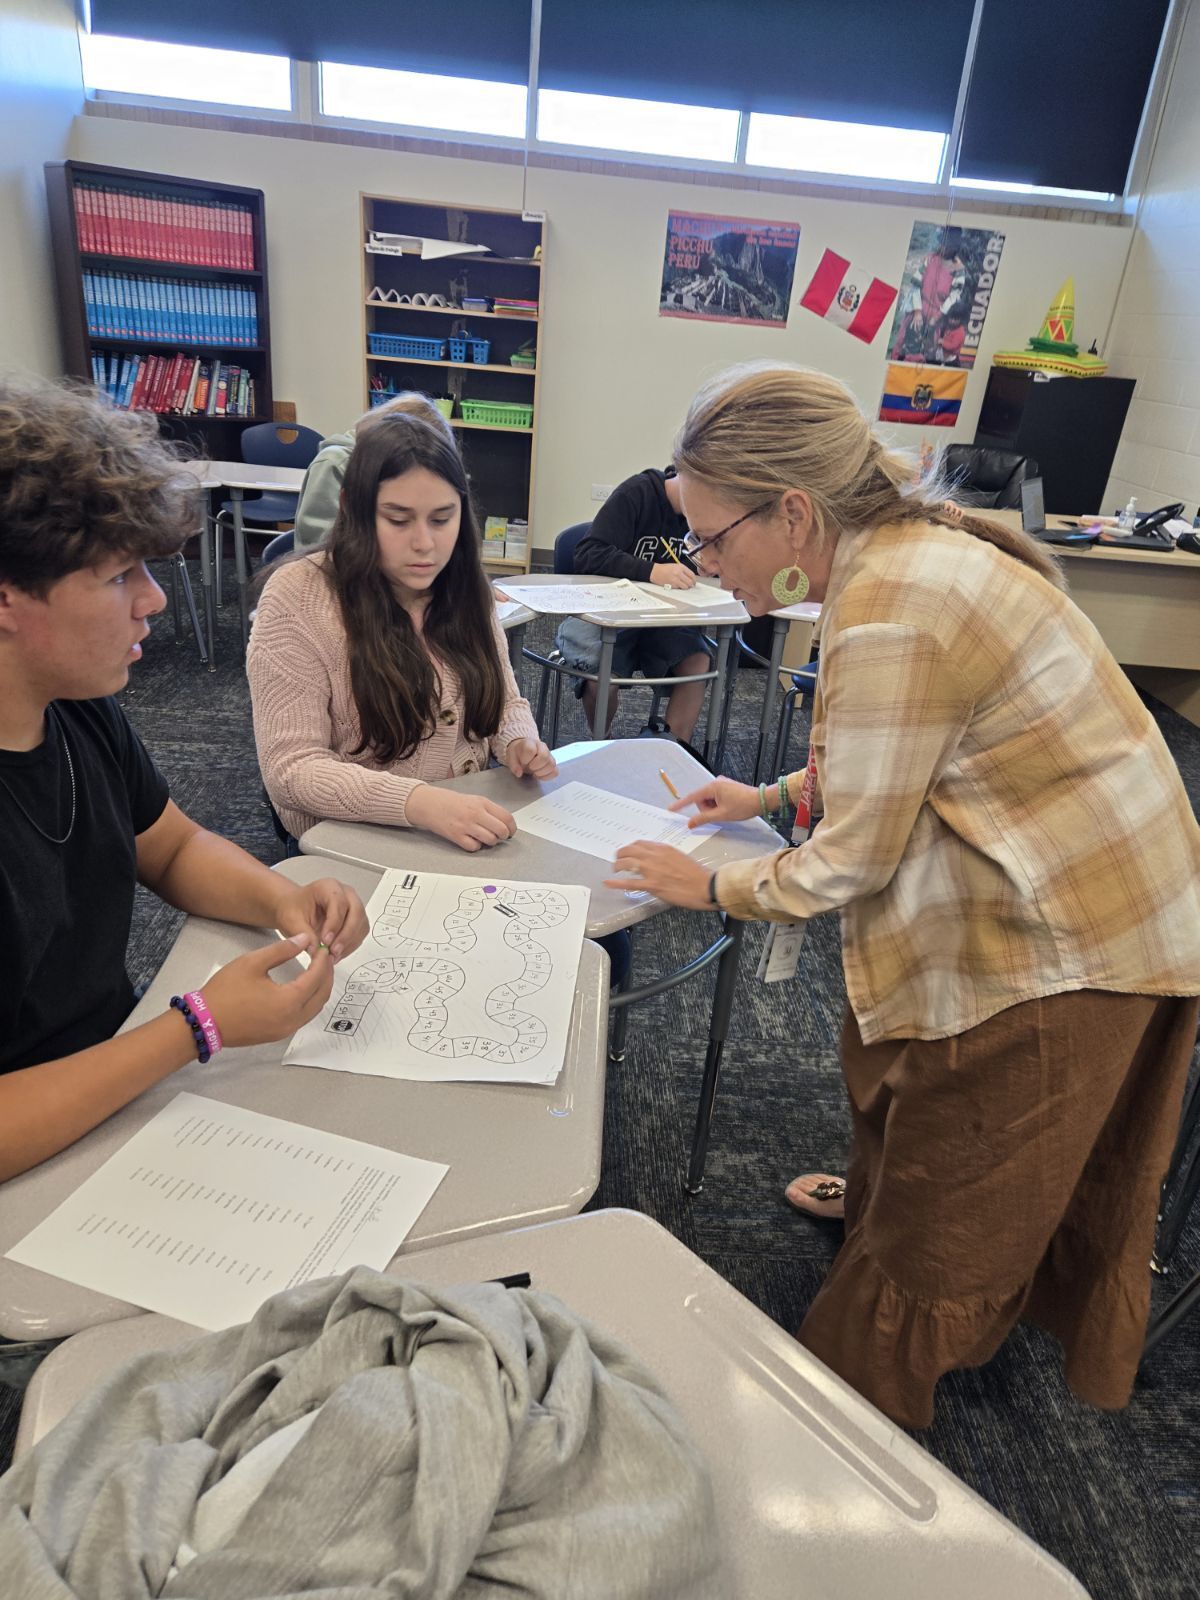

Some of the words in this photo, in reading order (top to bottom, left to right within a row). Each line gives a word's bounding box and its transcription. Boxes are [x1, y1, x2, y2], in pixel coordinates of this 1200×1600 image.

[670, 235, 713, 254] PICCHU
[668, 252, 700, 269] PERU
[964, 235, 1003, 347] ECUADOR
[435, 986, 444, 994] 45
[425, 996, 432, 1004] 44
[339, 1006, 348, 1015] 54
[424, 1021, 431, 1029] 42
[439, 1044, 447, 1052] 40
[461, 1041, 470, 1050] 39
[480, 1041, 491, 1050] 38
[498, 1050, 508, 1058] 37
[520, 1046, 529, 1054] 36
